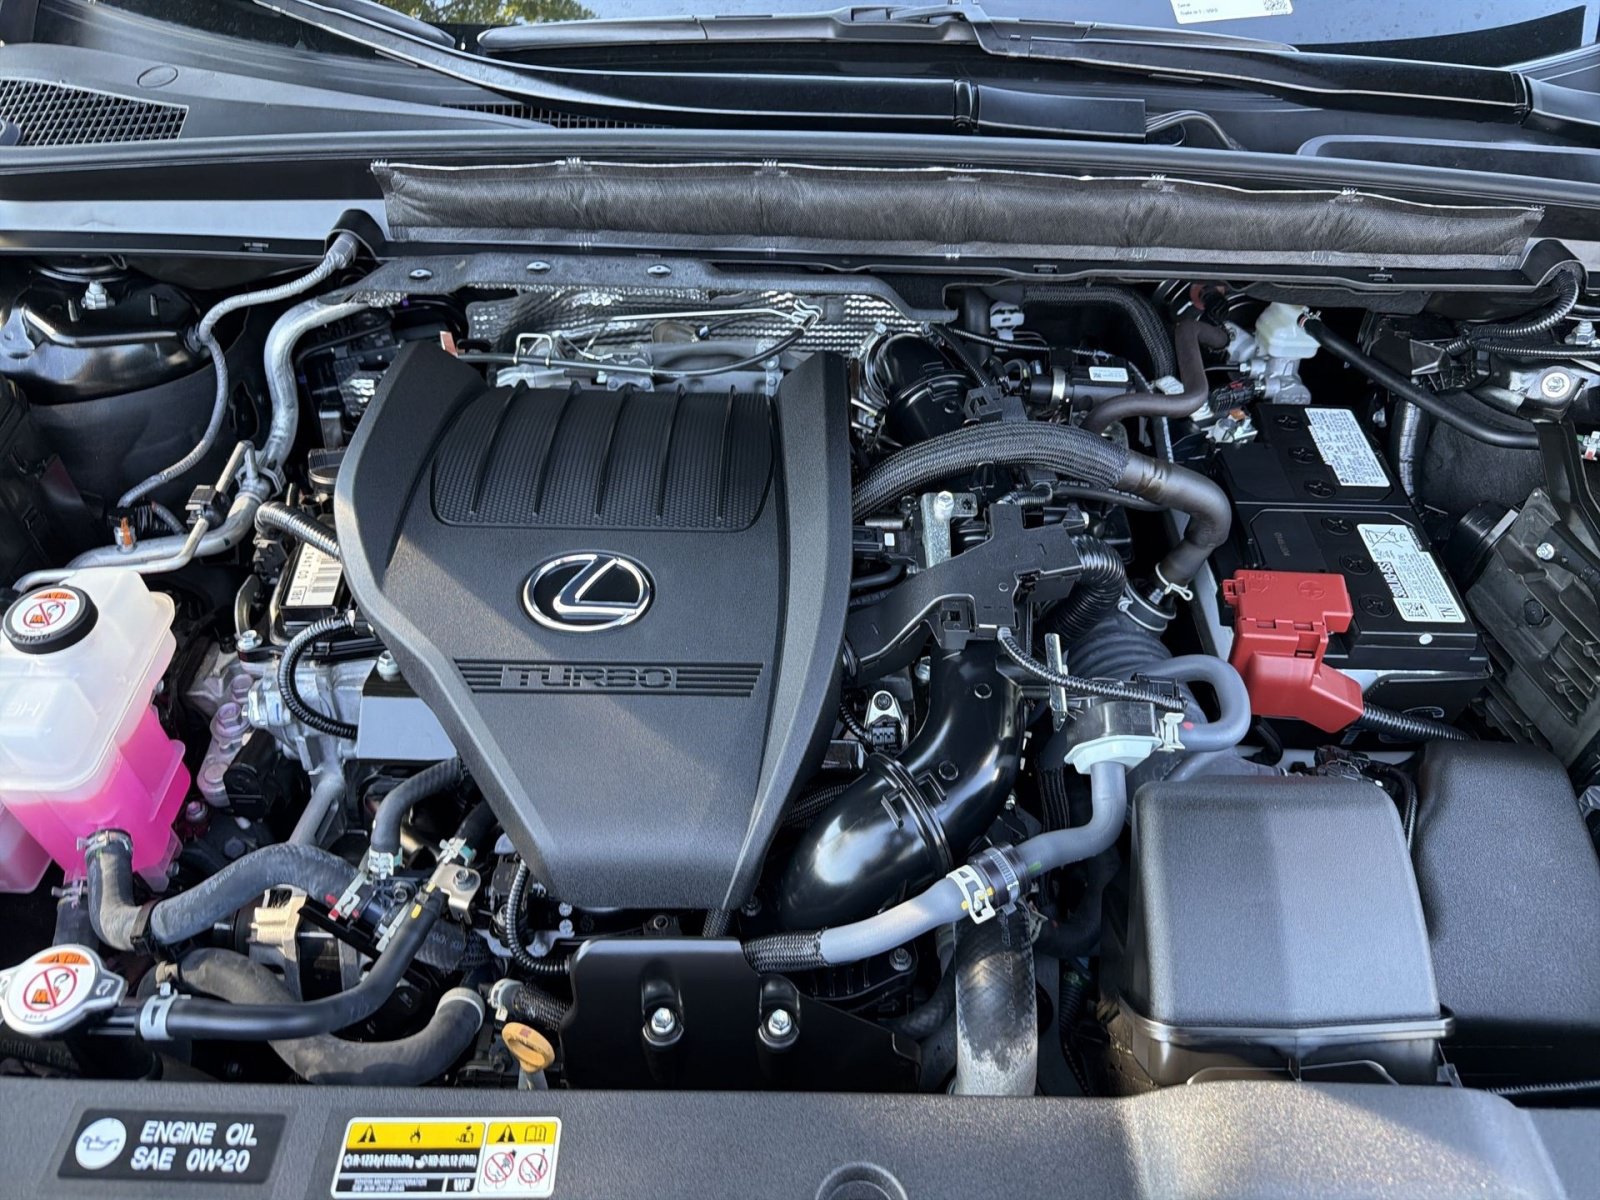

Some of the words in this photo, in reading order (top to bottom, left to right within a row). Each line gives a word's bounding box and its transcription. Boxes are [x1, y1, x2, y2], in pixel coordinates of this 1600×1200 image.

[500, 664, 677, 689] TURBO
[139, 1119, 217, 1145] ENGINE
[225, 1122, 258, 1147] OIL
[130, 1146, 177, 1171] SAE
[185, 1149, 251, 1173] 0W-20
